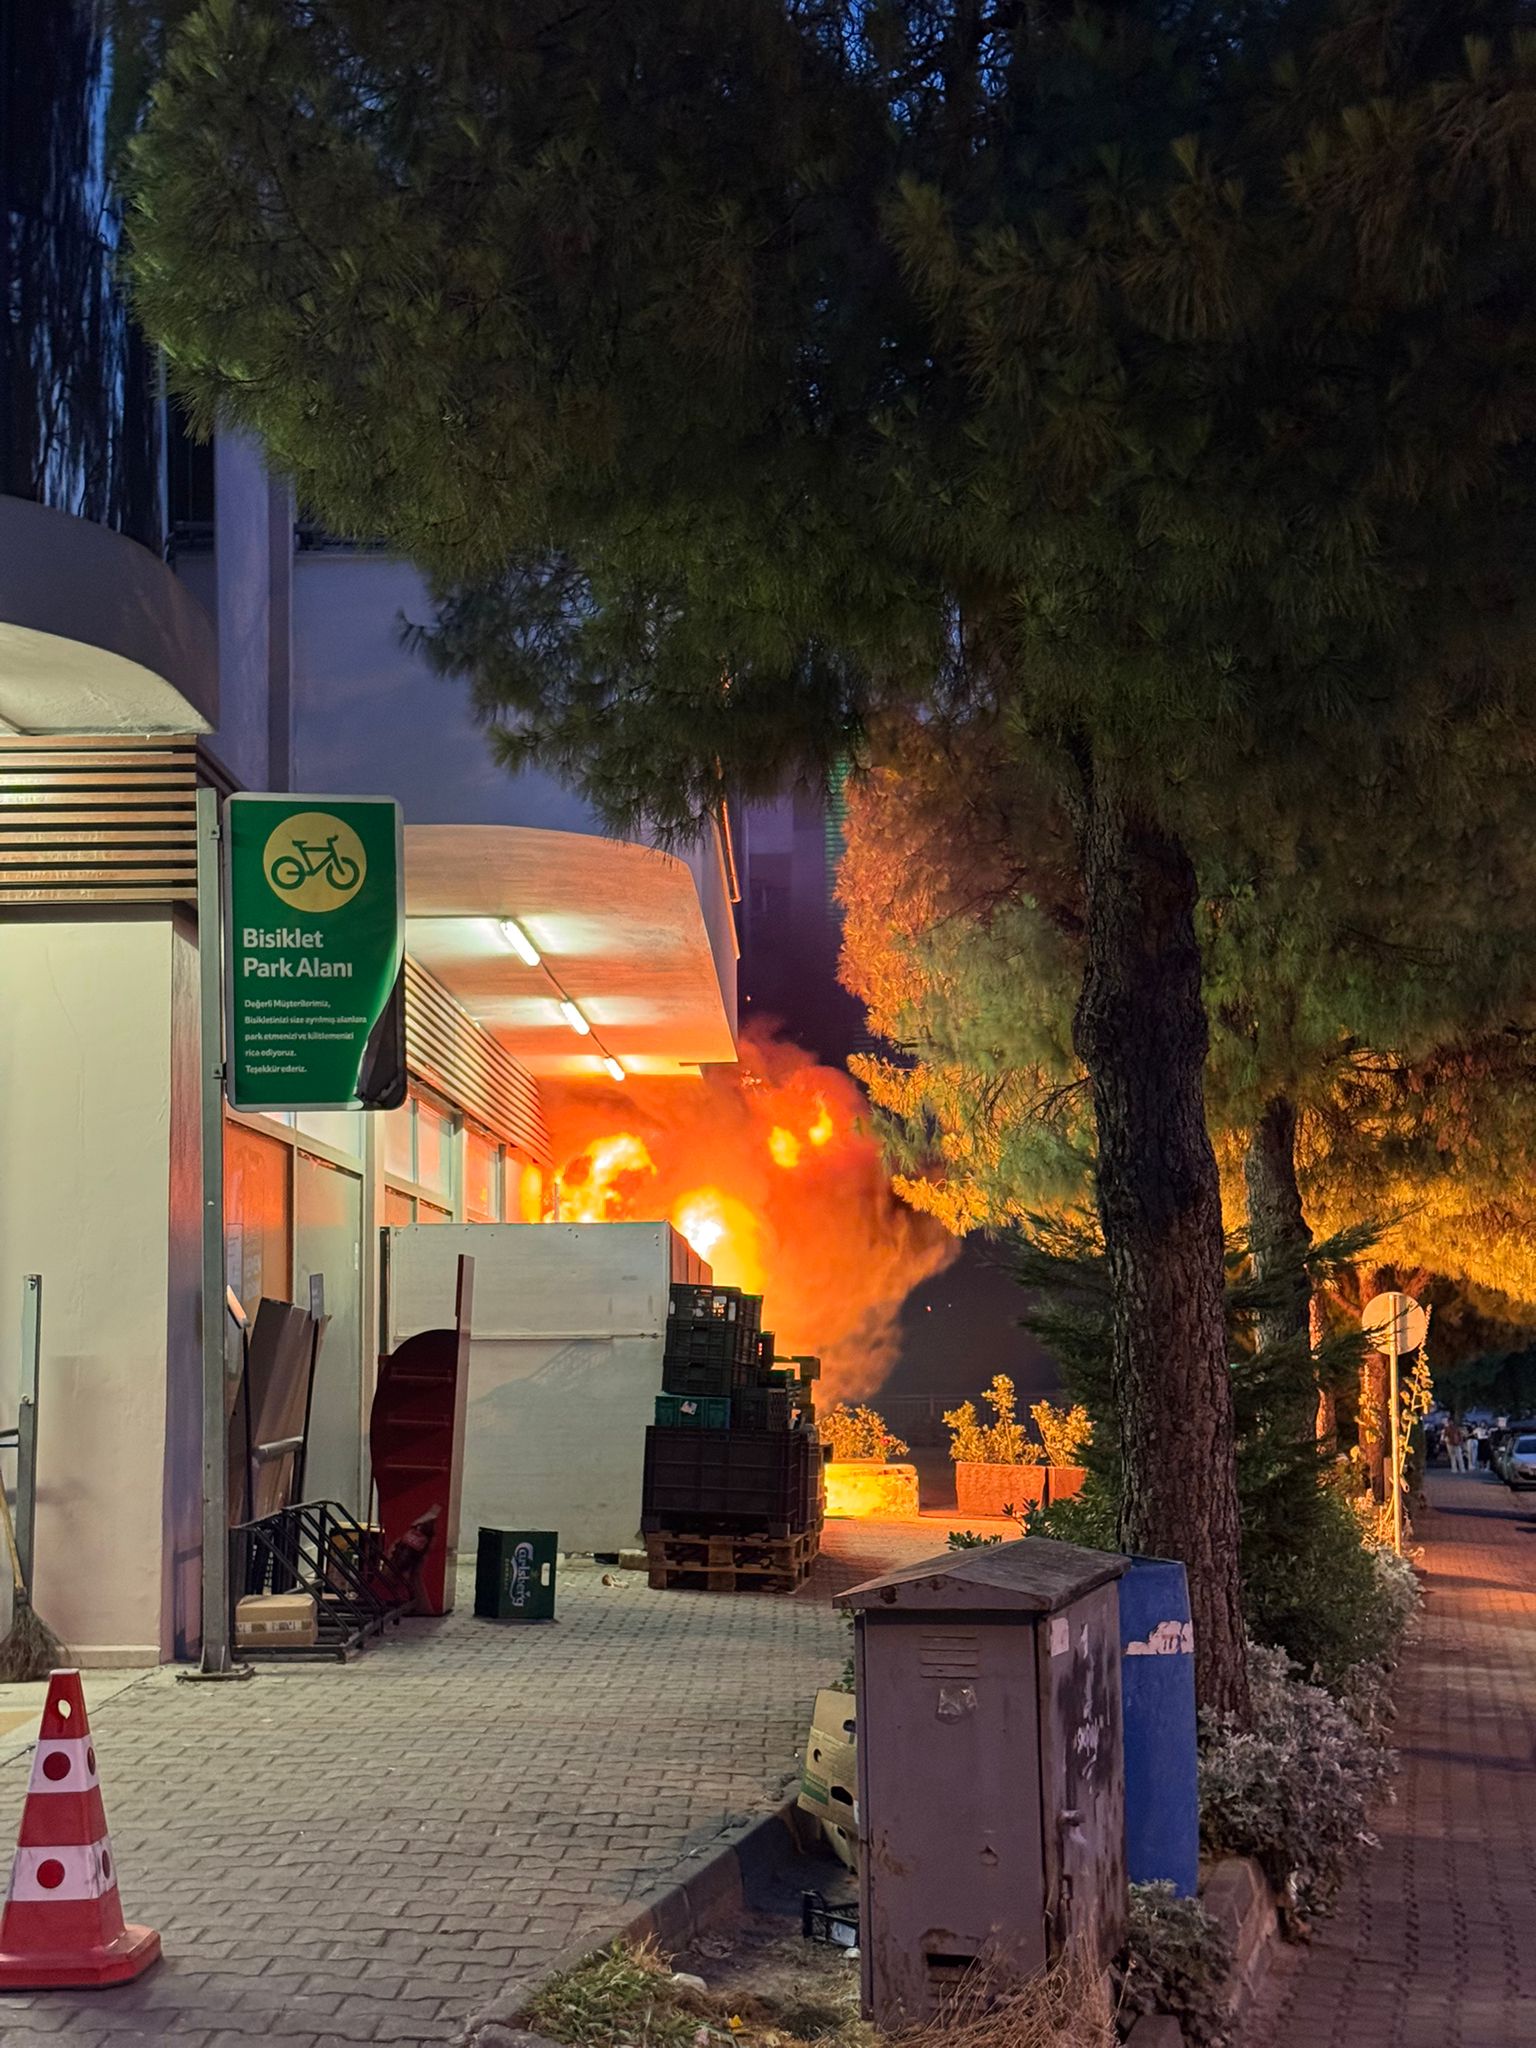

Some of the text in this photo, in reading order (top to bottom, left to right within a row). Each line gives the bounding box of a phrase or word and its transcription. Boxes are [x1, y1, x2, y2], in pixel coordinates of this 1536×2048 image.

[243, 928, 324, 948] Bisiklet
[243, 957, 353, 977] Park Alanı
[245, 1032, 263, 1042] park
[245, 1049, 260, 1057] rica
[509, 1542, 533, 1607] Carlsberg
